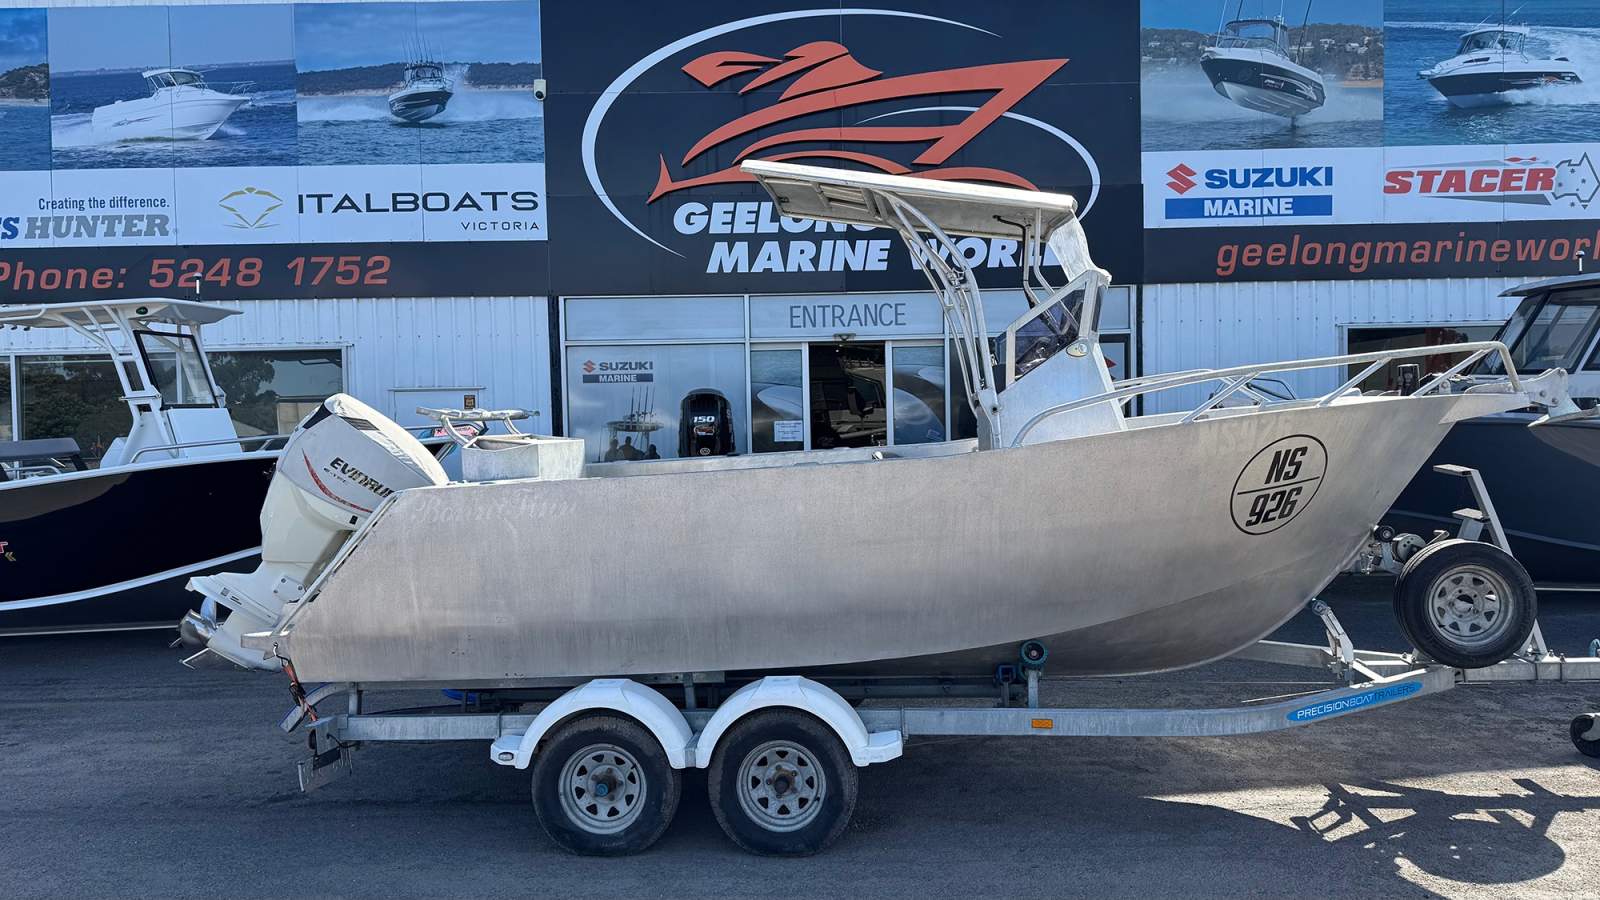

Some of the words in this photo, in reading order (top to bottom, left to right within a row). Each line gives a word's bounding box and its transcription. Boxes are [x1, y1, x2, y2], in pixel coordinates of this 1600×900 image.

[1205, 166, 1333, 189] SUZUKI
[1383, 167, 1557, 195] STACER
[38, 198, 86, 211] Creating
[88, 197, 106, 209] the
[109, 196, 170, 208] difference.
[297, 191, 539, 214] ITALBOATS
[1204, 198, 1294, 217] MARINE
[24, 214, 170, 239] HUNTER
[461, 221, 540, 231] VICTORIA
[706, 239, 891, 273] MARINE
[149, 257, 263, 288] 5248
[287, 255, 391, 286] 1752
[790, 302, 907, 329] ENTRANCE
[599, 361, 653, 371] SUZUKI
[599, 374, 638, 383] MARINE
[693, 415, 716, 423] 150
[1264, 446, 1308, 484] NS
[1245, 486, 1303, 527] 926
